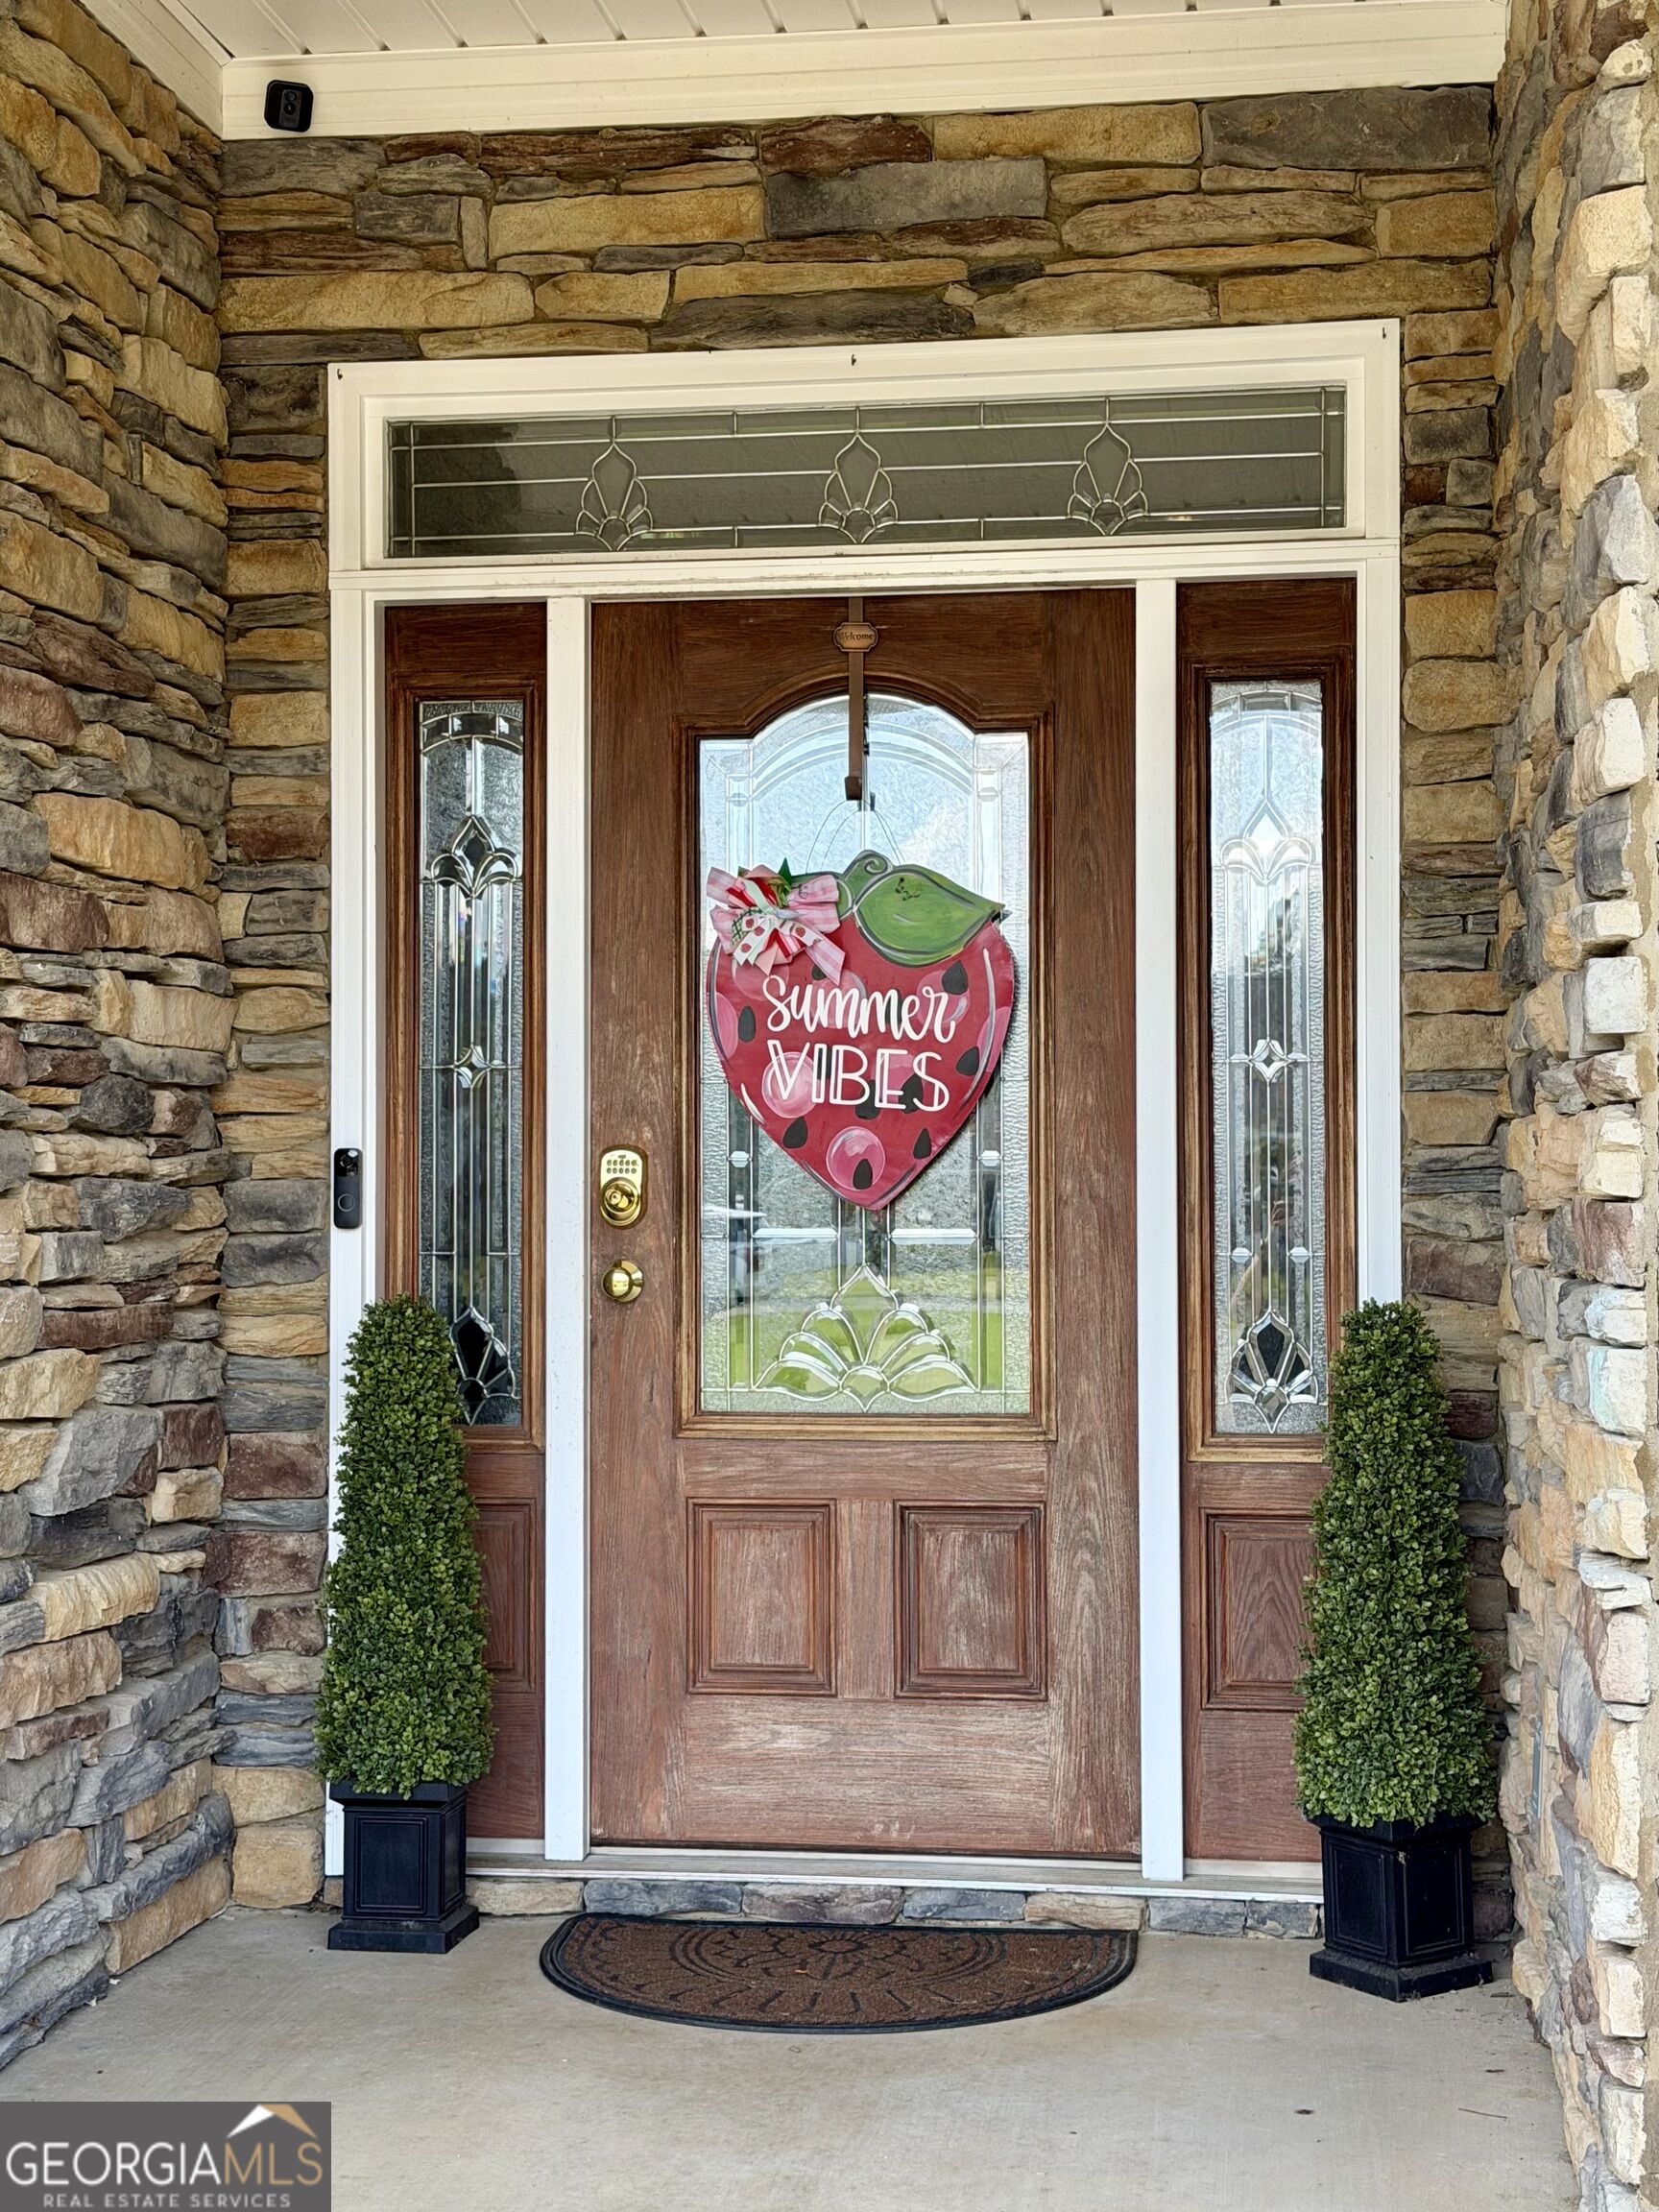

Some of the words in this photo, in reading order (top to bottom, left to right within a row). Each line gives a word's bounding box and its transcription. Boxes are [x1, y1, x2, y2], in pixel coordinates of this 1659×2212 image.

[838, 632, 874, 640] Welcome
[762, 974, 956, 1043] Summer
[767, 1040, 950, 1112] VIBES
